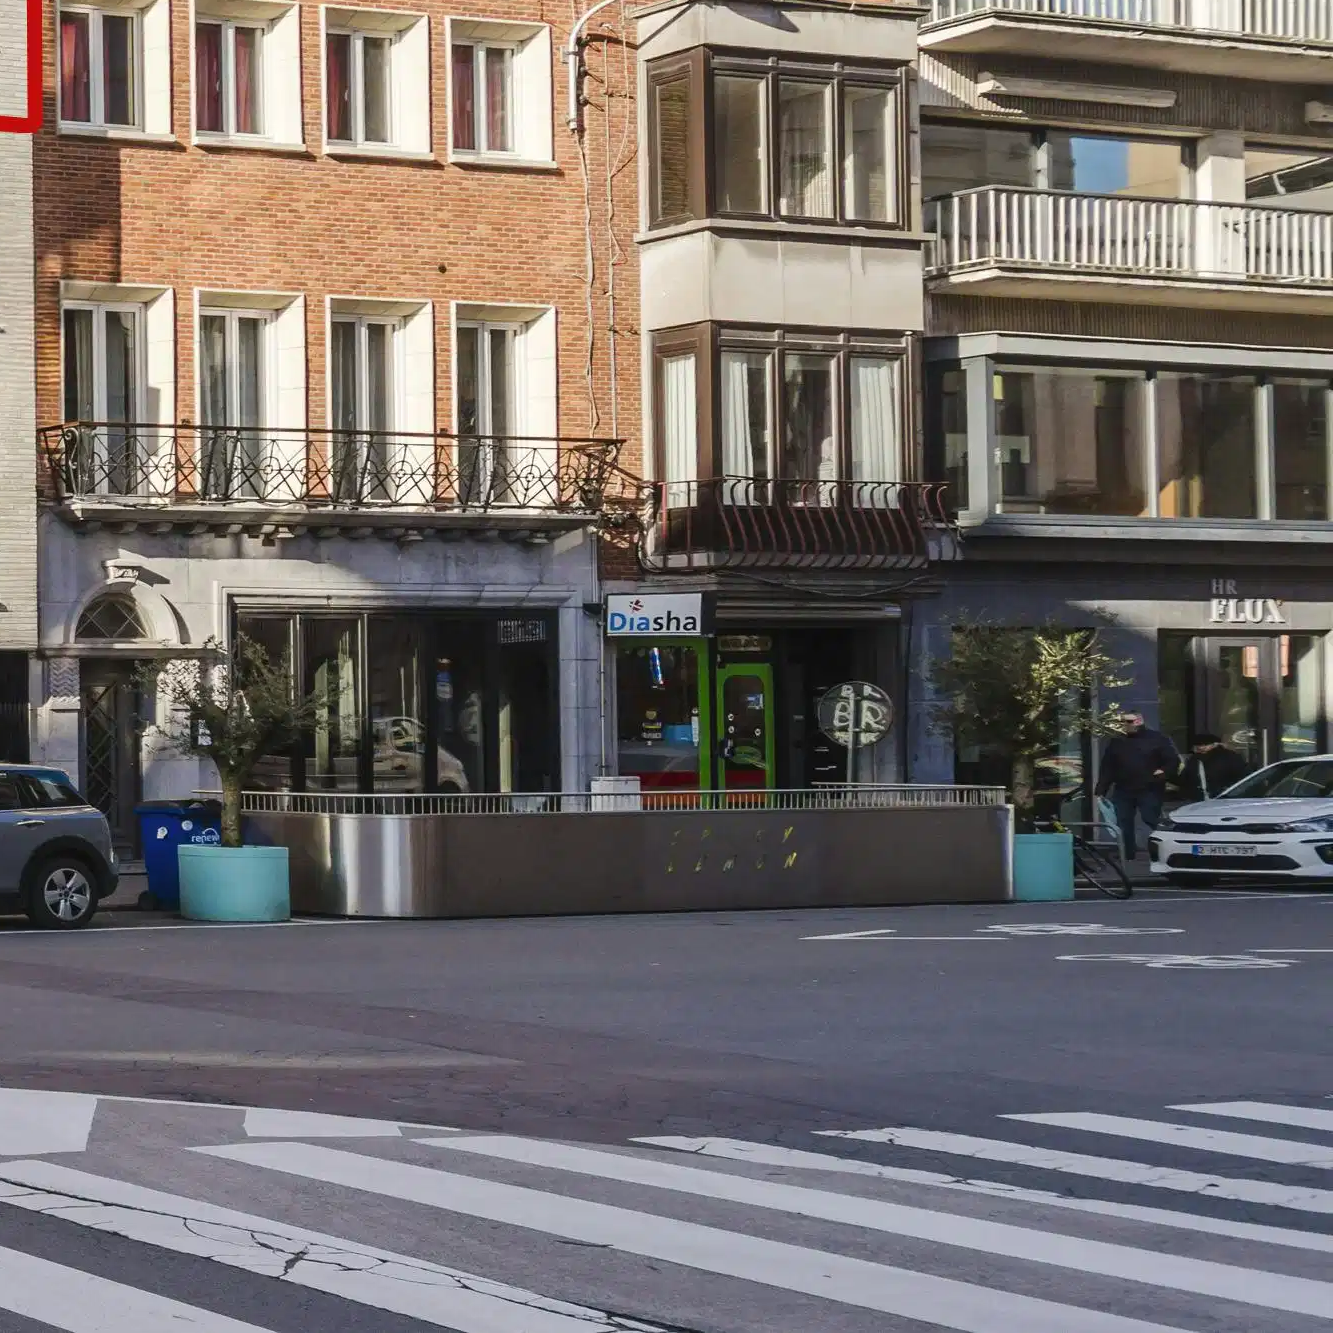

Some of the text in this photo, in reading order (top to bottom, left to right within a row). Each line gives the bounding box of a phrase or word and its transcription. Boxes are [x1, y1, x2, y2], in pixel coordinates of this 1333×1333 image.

[1212, 578, 1238, 595] HR
[609, 610, 697, 632] Diasha
[1209, 598, 1286, 623] FLUX
